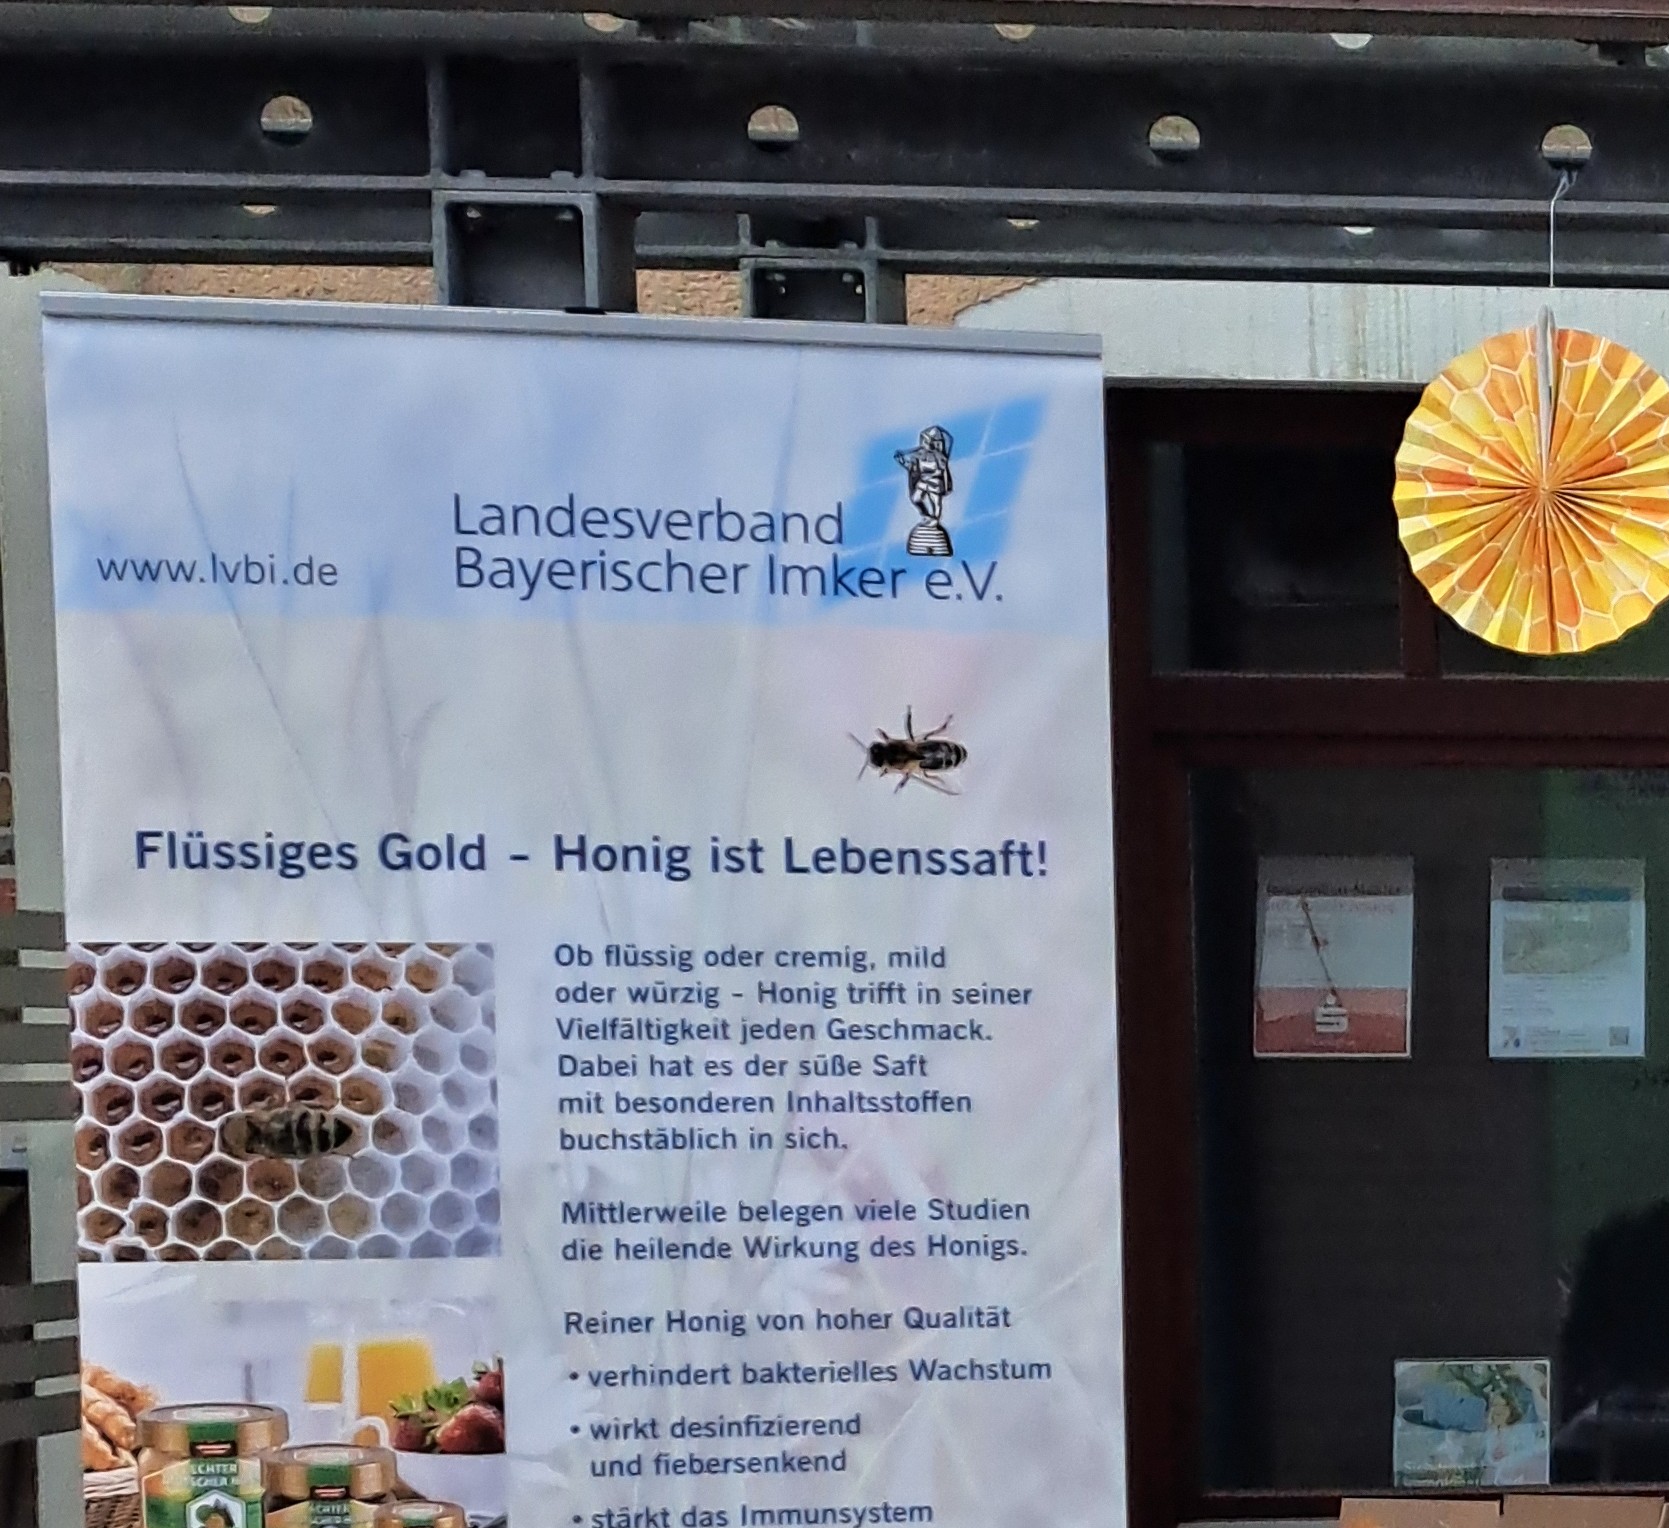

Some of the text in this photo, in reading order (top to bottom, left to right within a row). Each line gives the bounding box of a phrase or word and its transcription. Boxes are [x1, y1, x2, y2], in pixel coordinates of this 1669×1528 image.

[453, 492, 844, 546] Landesverband
[96, 551, 338, 587] www.lvbi.de
[455, 545, 1003, 602] Bayerischer Imker e.V.
[135, 830, 1047, 882] Flüssiges Gold Honig ist Lebenssaft!
[554, 943, 946, 974] Ob flüssig oder cremig, mild
[555, 980, 1033, 1010] oder würzig Honig trifft in seiner
[555, 1016, 993, 1046] Vielfältigkeit jeden Geschmack.
[558, 1053, 928, 1078] Dabei hat es der süße Saft
[558, 1089, 972, 1115] mit besonderen Inhaltsstoffen
[559, 1126, 848, 1151] buchstäblich in sich.
[562, 1197, 1030, 1228] Mittlerweile belegen viele Studien
[561, 1233, 1028, 1264] die heilende Wirkung des Honigs.
[564, 1305, 1012, 1338] Reiner Honig von hoher Qualität
[587, 1358, 1052, 1388] verhindert bakterielles Wachstum
[589, 1412, 862, 1441] wirkt desinfizierend
[590, 1448, 847, 1478] und fiebersenkend
[680, 1505, 730, 1528] das
